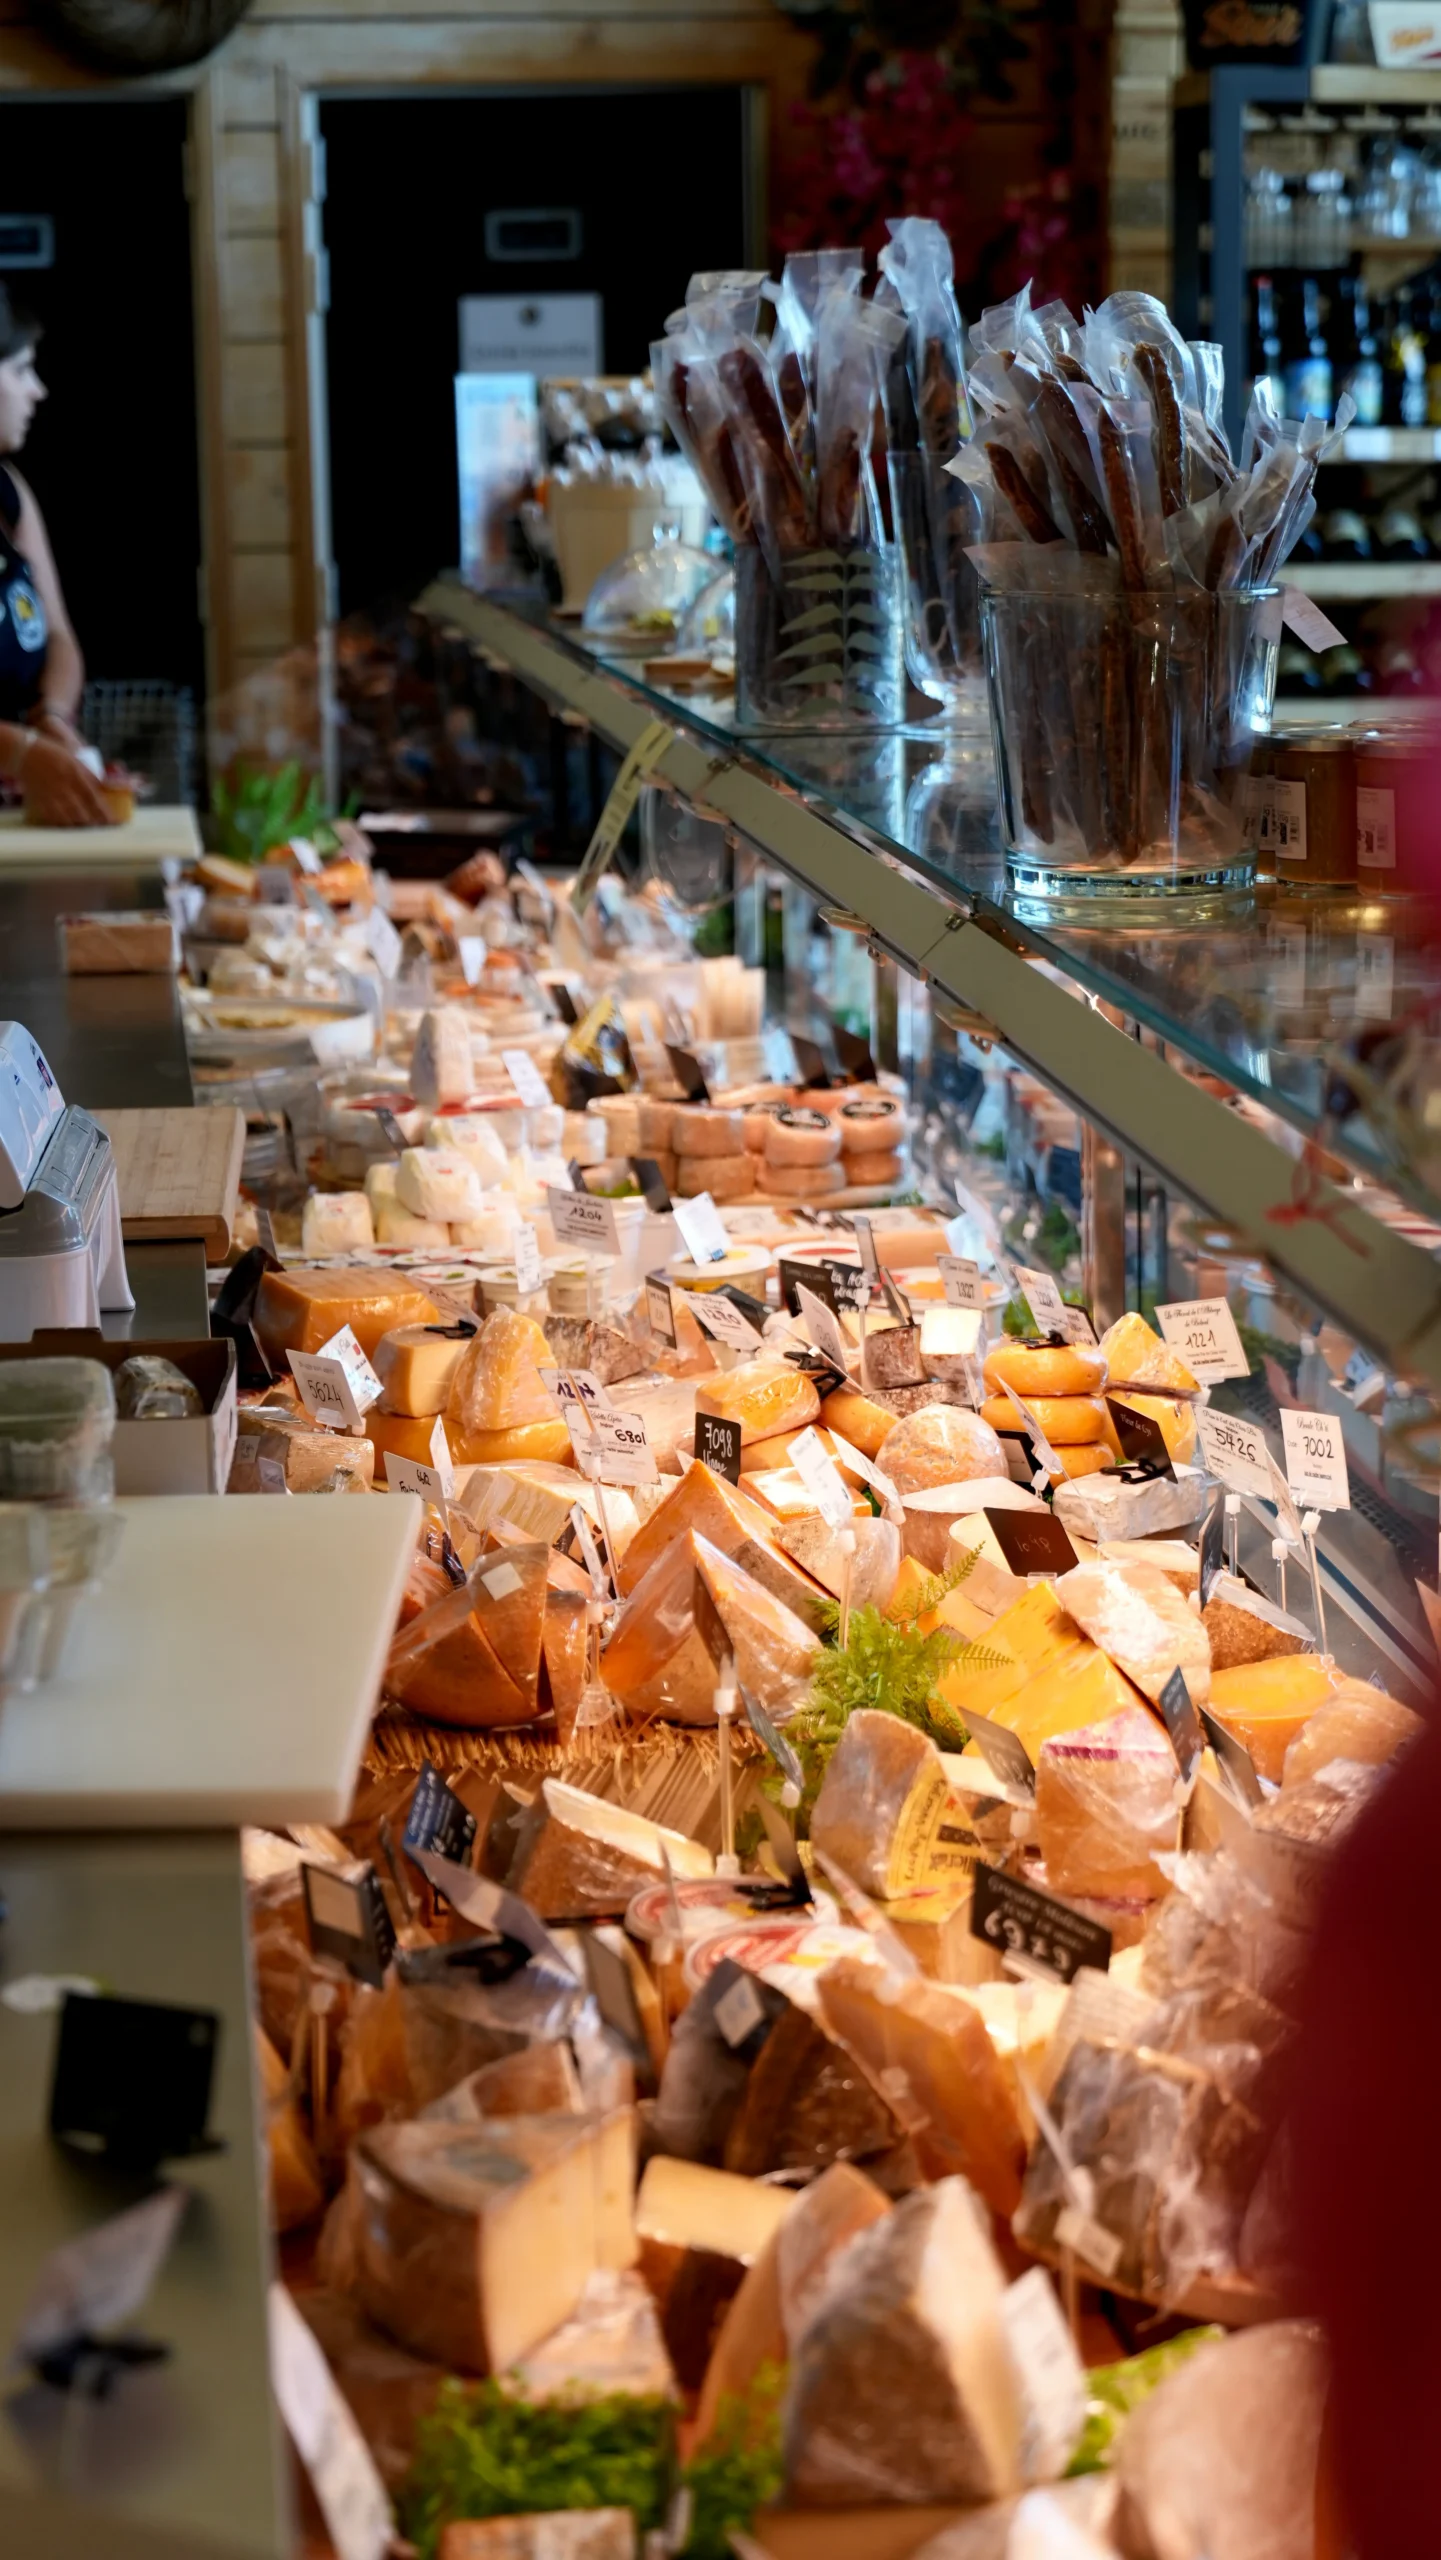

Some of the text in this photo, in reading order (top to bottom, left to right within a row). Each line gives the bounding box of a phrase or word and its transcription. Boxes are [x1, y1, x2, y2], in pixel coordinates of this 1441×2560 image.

[1185, 1329, 1217, 1348] 1221
[307, 1380, 345, 1410] 5624
[614, 1429, 647, 1445] 6801
[704, 1422, 733, 1458] 7098
[1303, 1436, 1335, 1458] 7002
